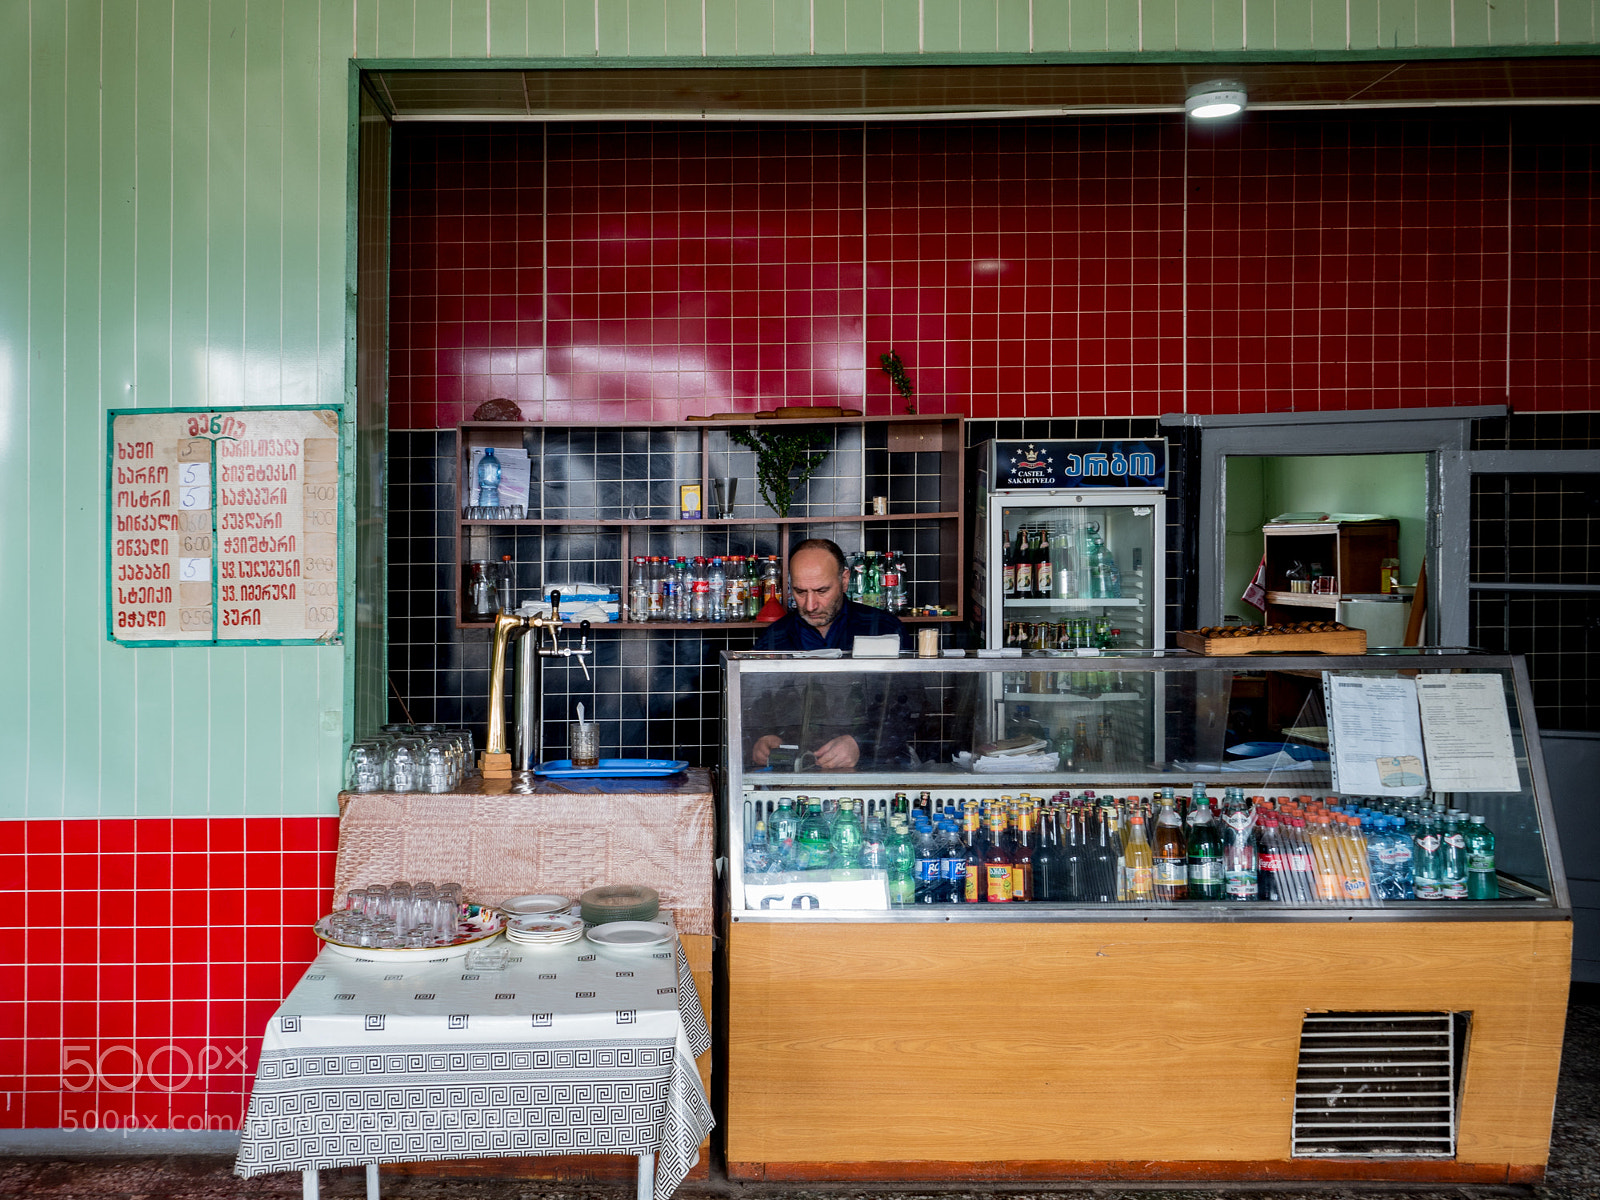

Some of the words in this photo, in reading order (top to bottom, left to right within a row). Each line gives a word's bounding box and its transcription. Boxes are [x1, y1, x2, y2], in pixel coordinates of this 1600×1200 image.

[187, 414, 247, 438] მენიუ
[118, 442, 154, 459] ხაში
[182, 441, 201, 457] 5
[118, 466, 168, 485] ხარჩო
[184, 464, 201, 483] 5
[1007, 477, 1056, 485] SAKARTVELO
[1018, 470, 1045, 478] CASTEL
[118, 489, 170, 508] ოსტრი
[183, 486, 201, 507] 5
[221, 487, 287, 506] ხაჭაპური
[117, 514, 178, 532] ხინკალი
[117, 538, 169, 556] მწვადი
[224, 535, 296, 554] ჭვიშტარი
[118, 562, 170, 581] ქაბაბი
[184, 559, 201, 578] 5
[118, 586, 172, 604] სტეიქი
[240, 583, 296, 601] იმერული
[118, 610, 166, 627] მჭადი
[222, 608, 260, 626] პური
